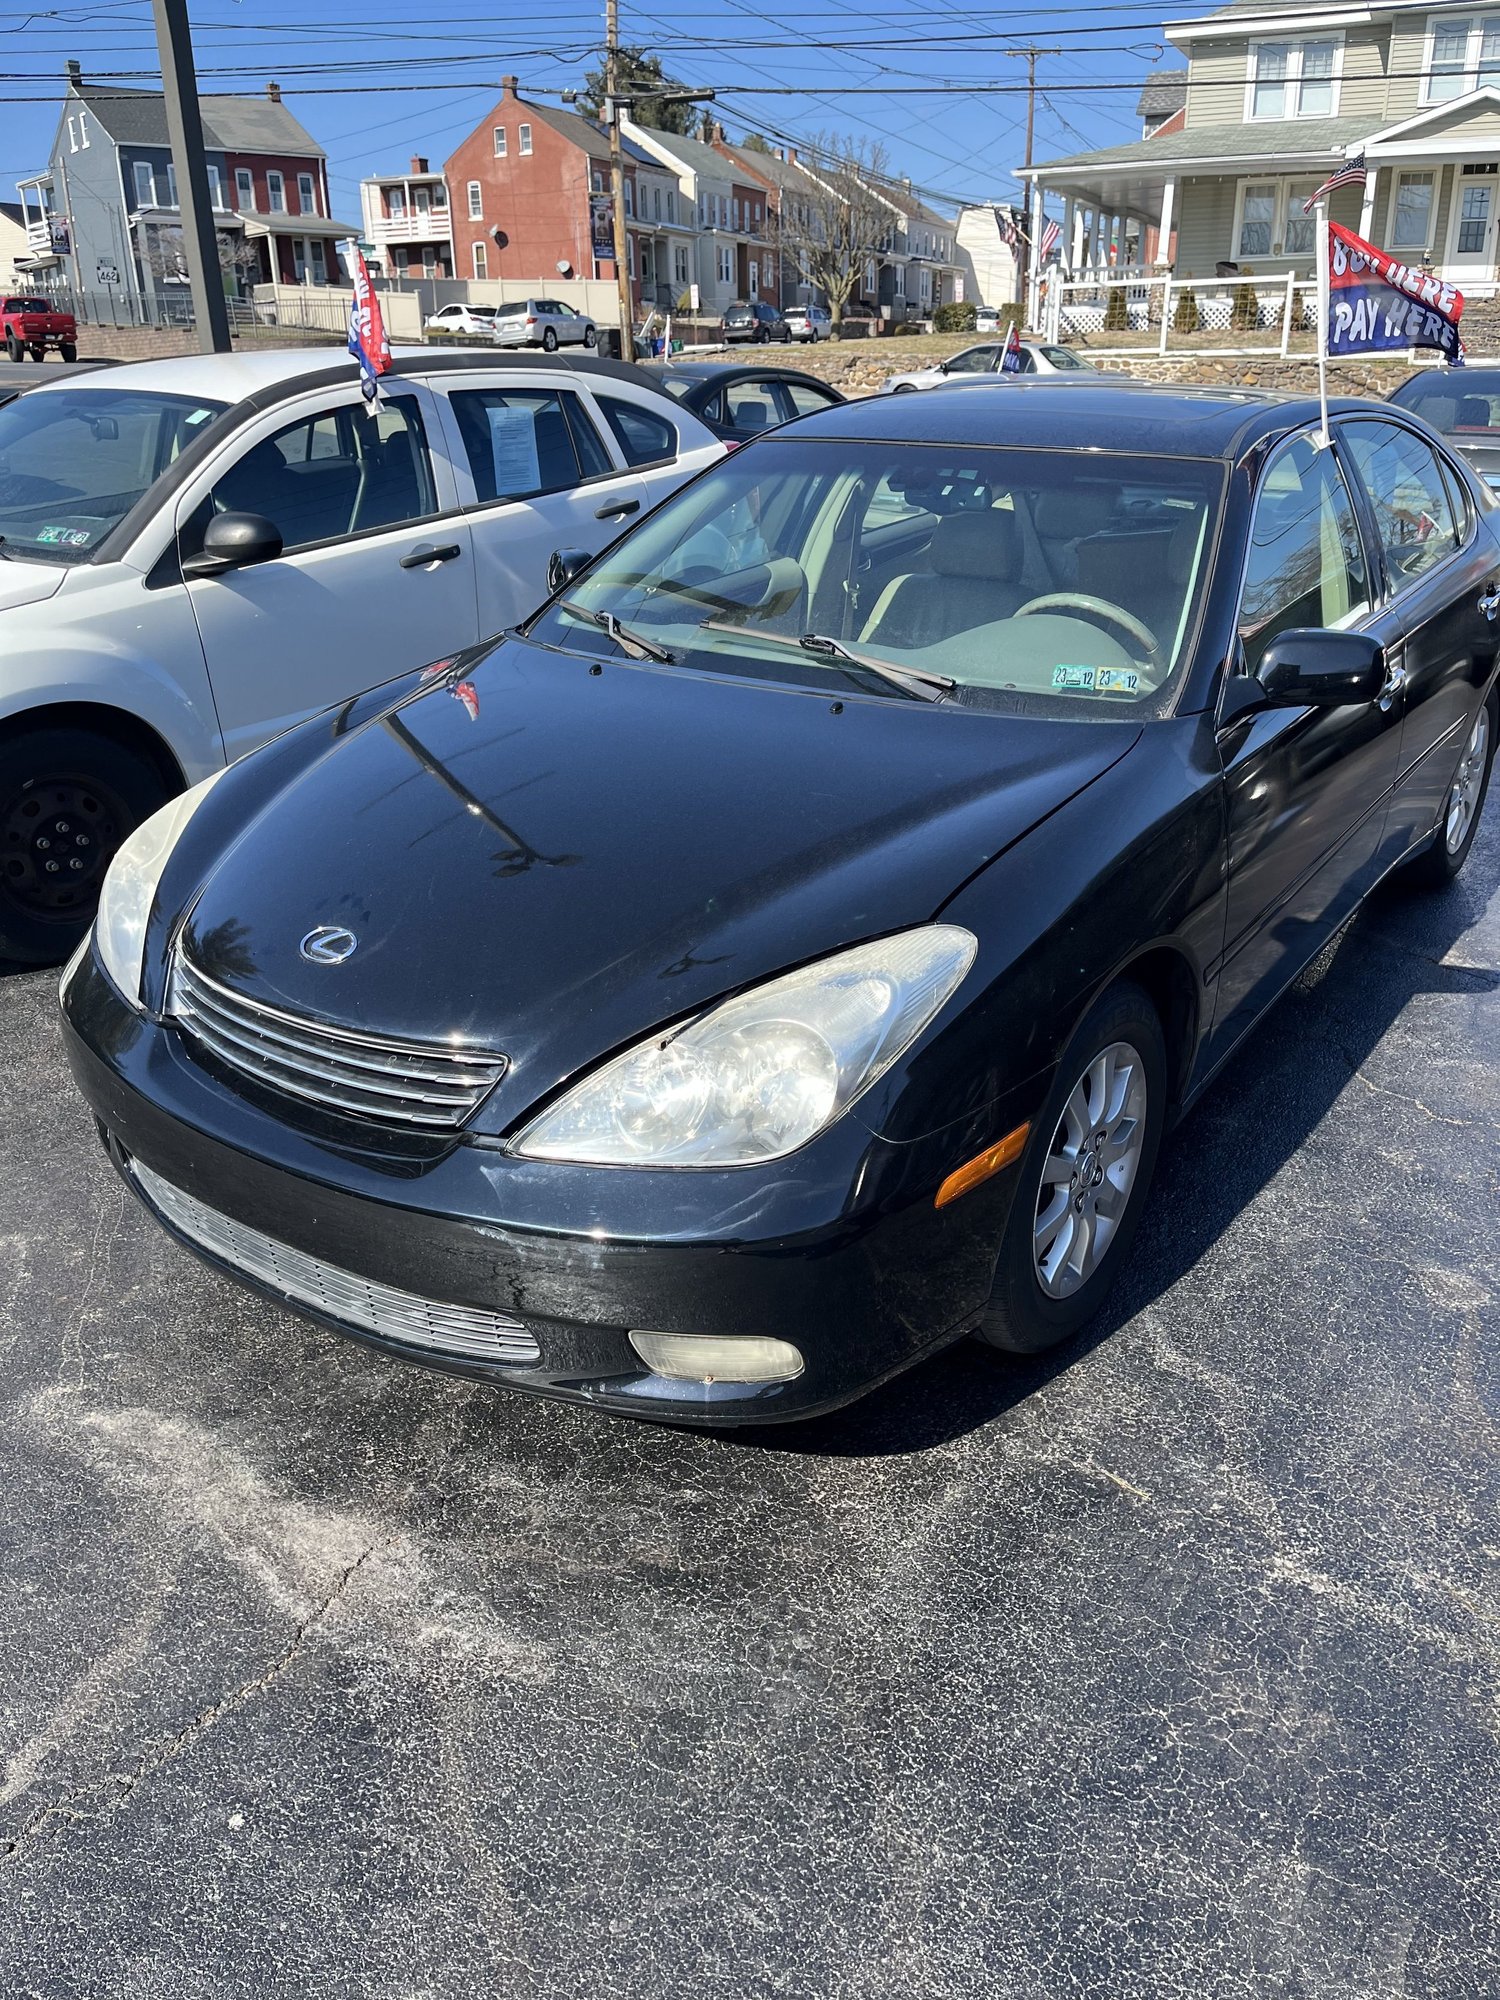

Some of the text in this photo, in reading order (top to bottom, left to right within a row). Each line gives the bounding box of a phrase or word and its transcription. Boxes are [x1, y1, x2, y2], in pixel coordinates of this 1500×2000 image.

[100, 271, 116, 281] 462
[1385, 262, 1458, 314] HERE
[1333, 297, 1455, 348] PAY HERE
[1056, 668, 1093, 685] 23 12
[1100, 670, 1137, 689] 23 12
